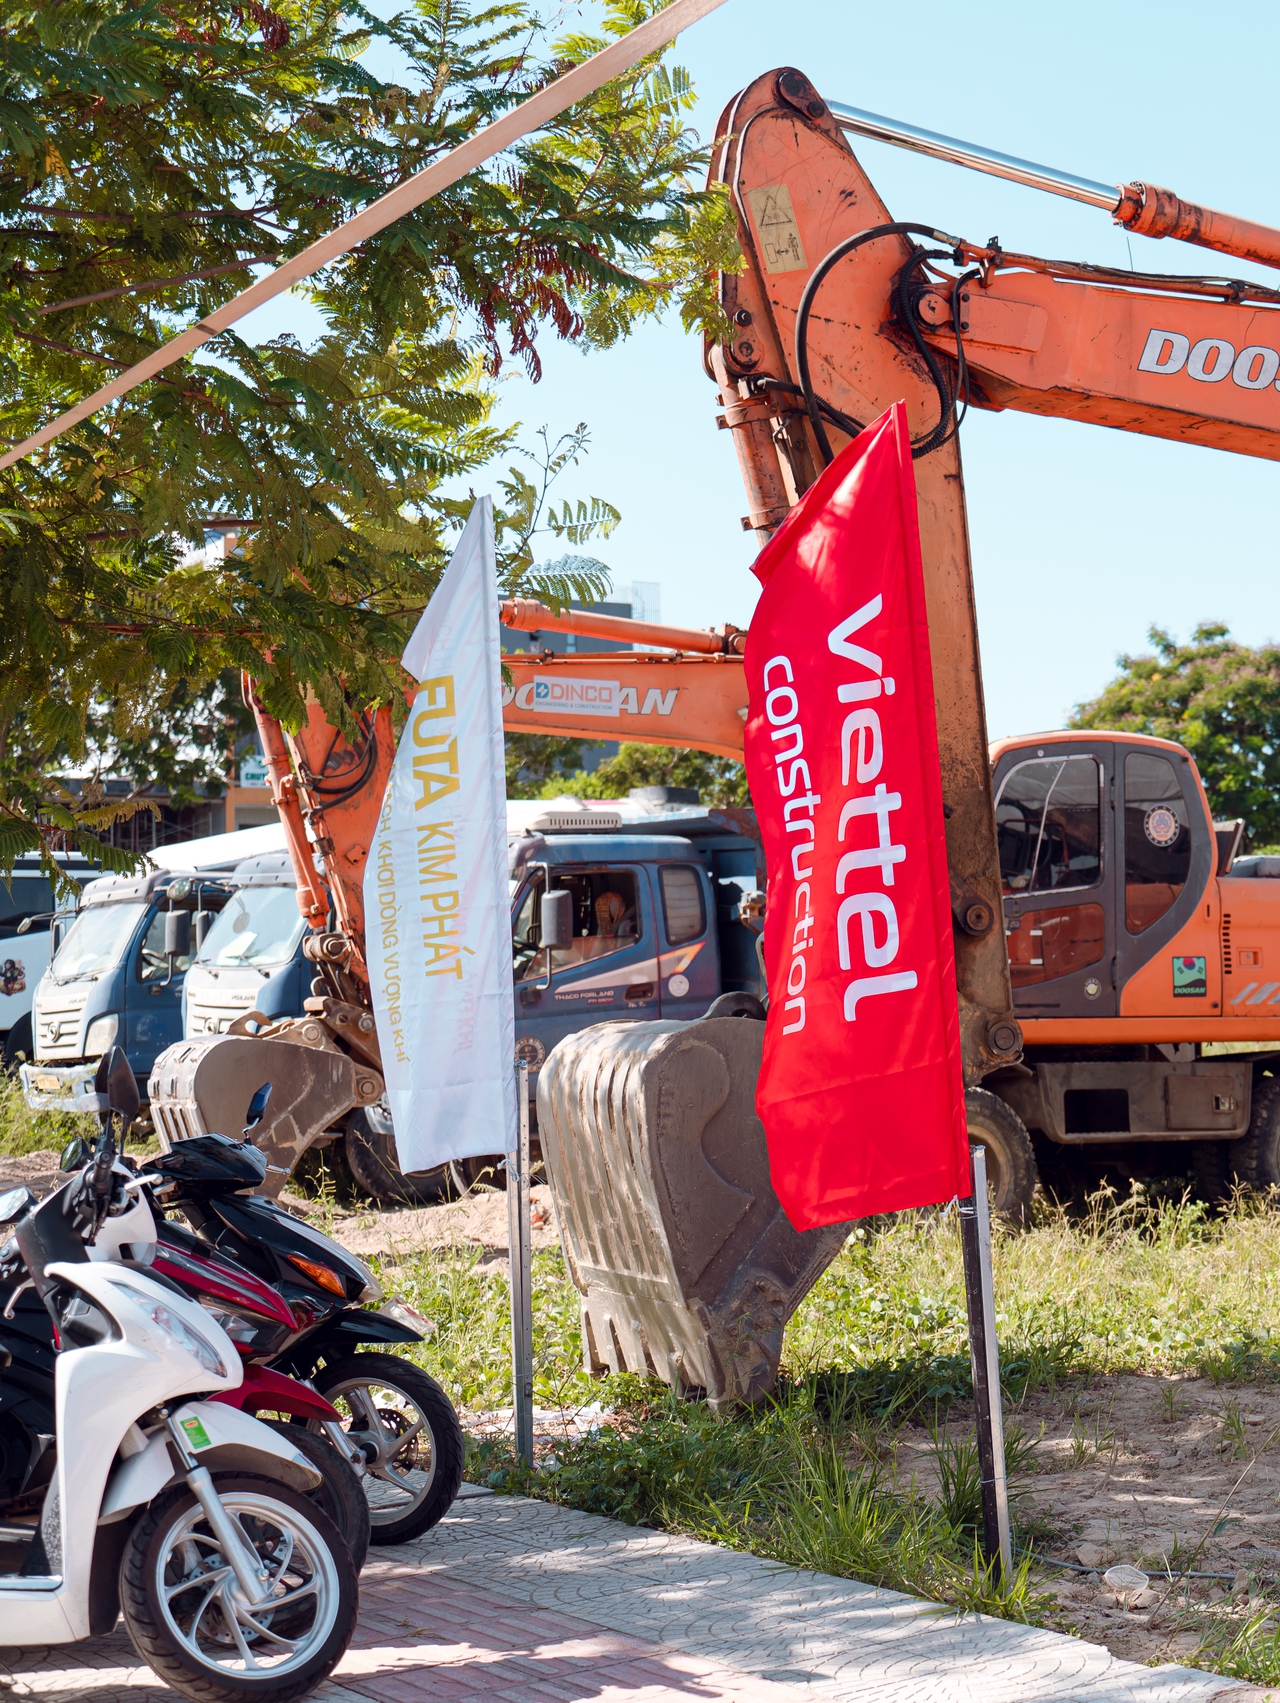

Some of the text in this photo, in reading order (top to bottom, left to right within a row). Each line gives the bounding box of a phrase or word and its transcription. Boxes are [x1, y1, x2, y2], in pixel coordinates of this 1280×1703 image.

[535, 701, 570, 709] ENGINEERING
[574, 703, 613, 711] CONSTRUCTION
[550, 683, 613, 703] DINCO
[412, 674, 476, 980] FUTA KIM PHÁT
[763, 655, 821, 1035] construction
[378, 890, 402, 949] DÒNG
[382, 951, 402, 1027] VƯỢNG
[554, 990, 614, 1001] THACO FORLAND
[1174, 986, 1206, 994] DOOSAN
[393, 1028, 411, 1063] KHÍ
